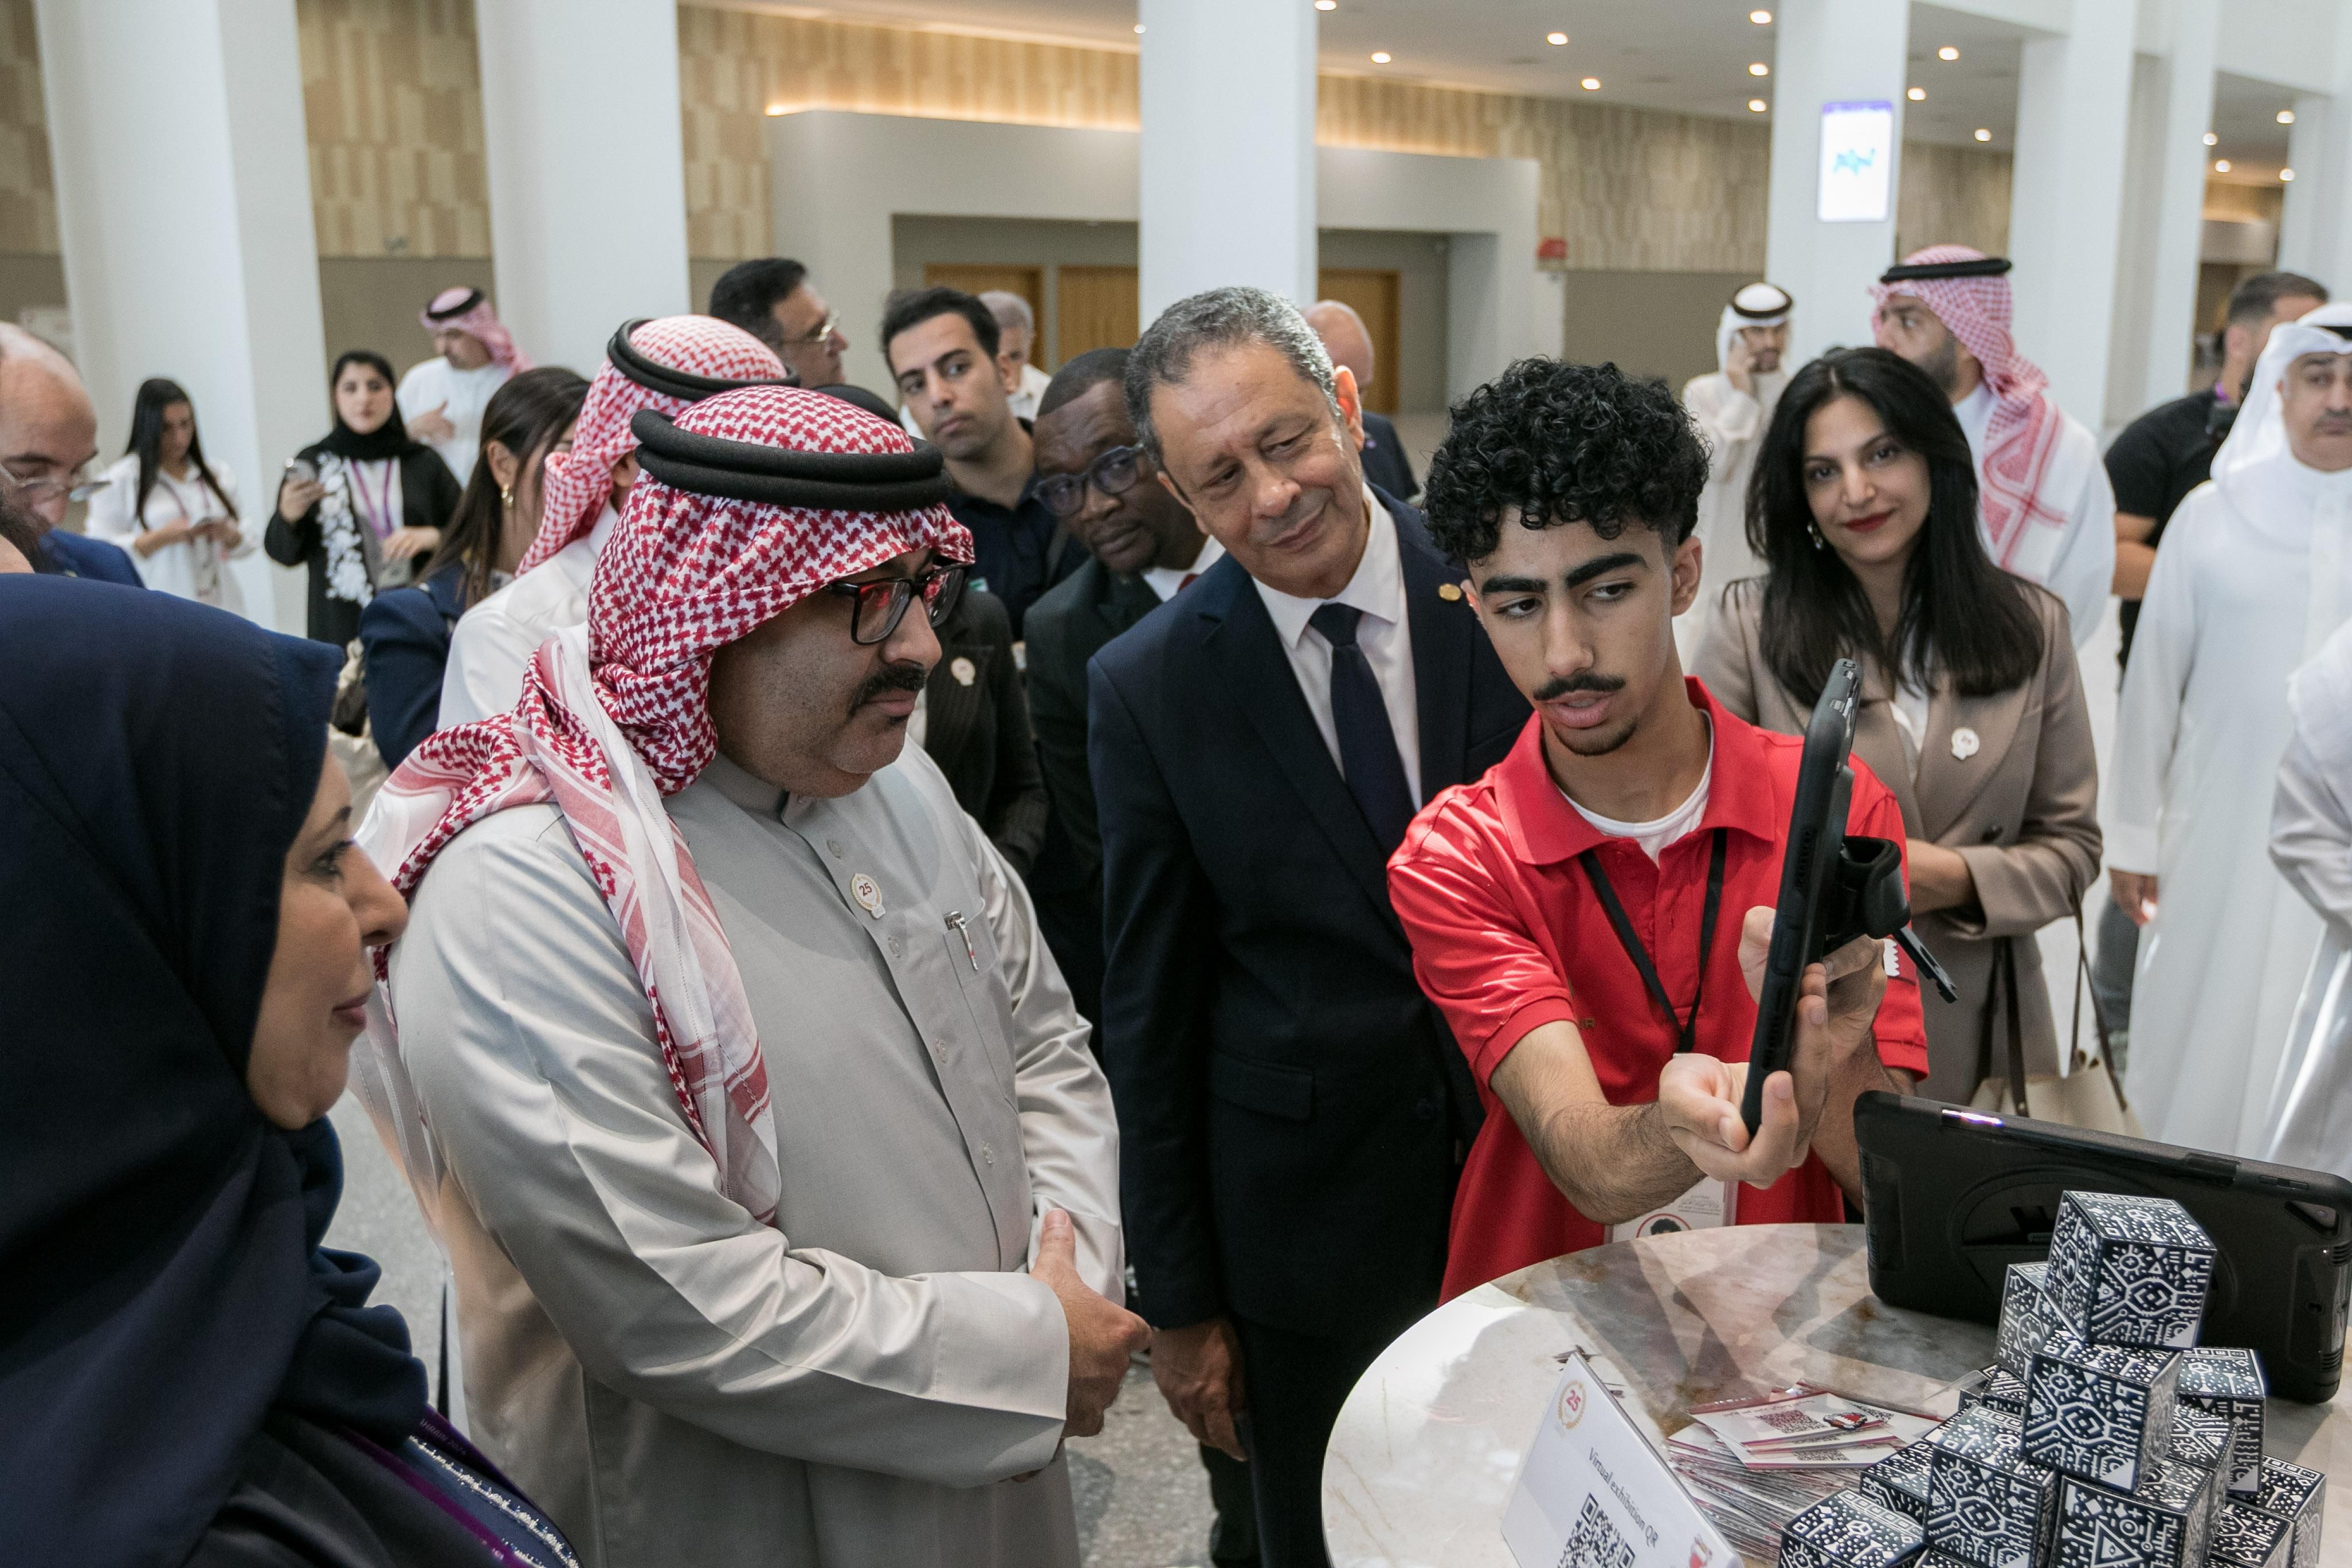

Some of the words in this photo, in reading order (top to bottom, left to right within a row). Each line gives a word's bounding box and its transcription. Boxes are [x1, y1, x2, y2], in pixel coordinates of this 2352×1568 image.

[859, 883, 872, 896] 25
[1566, 1389, 1581, 1412] 25
[1589, 1447, 1613, 1484] Virtual
[1610, 1481, 1645, 1531] exhibition
[1645, 1525, 1658, 1548] QR
